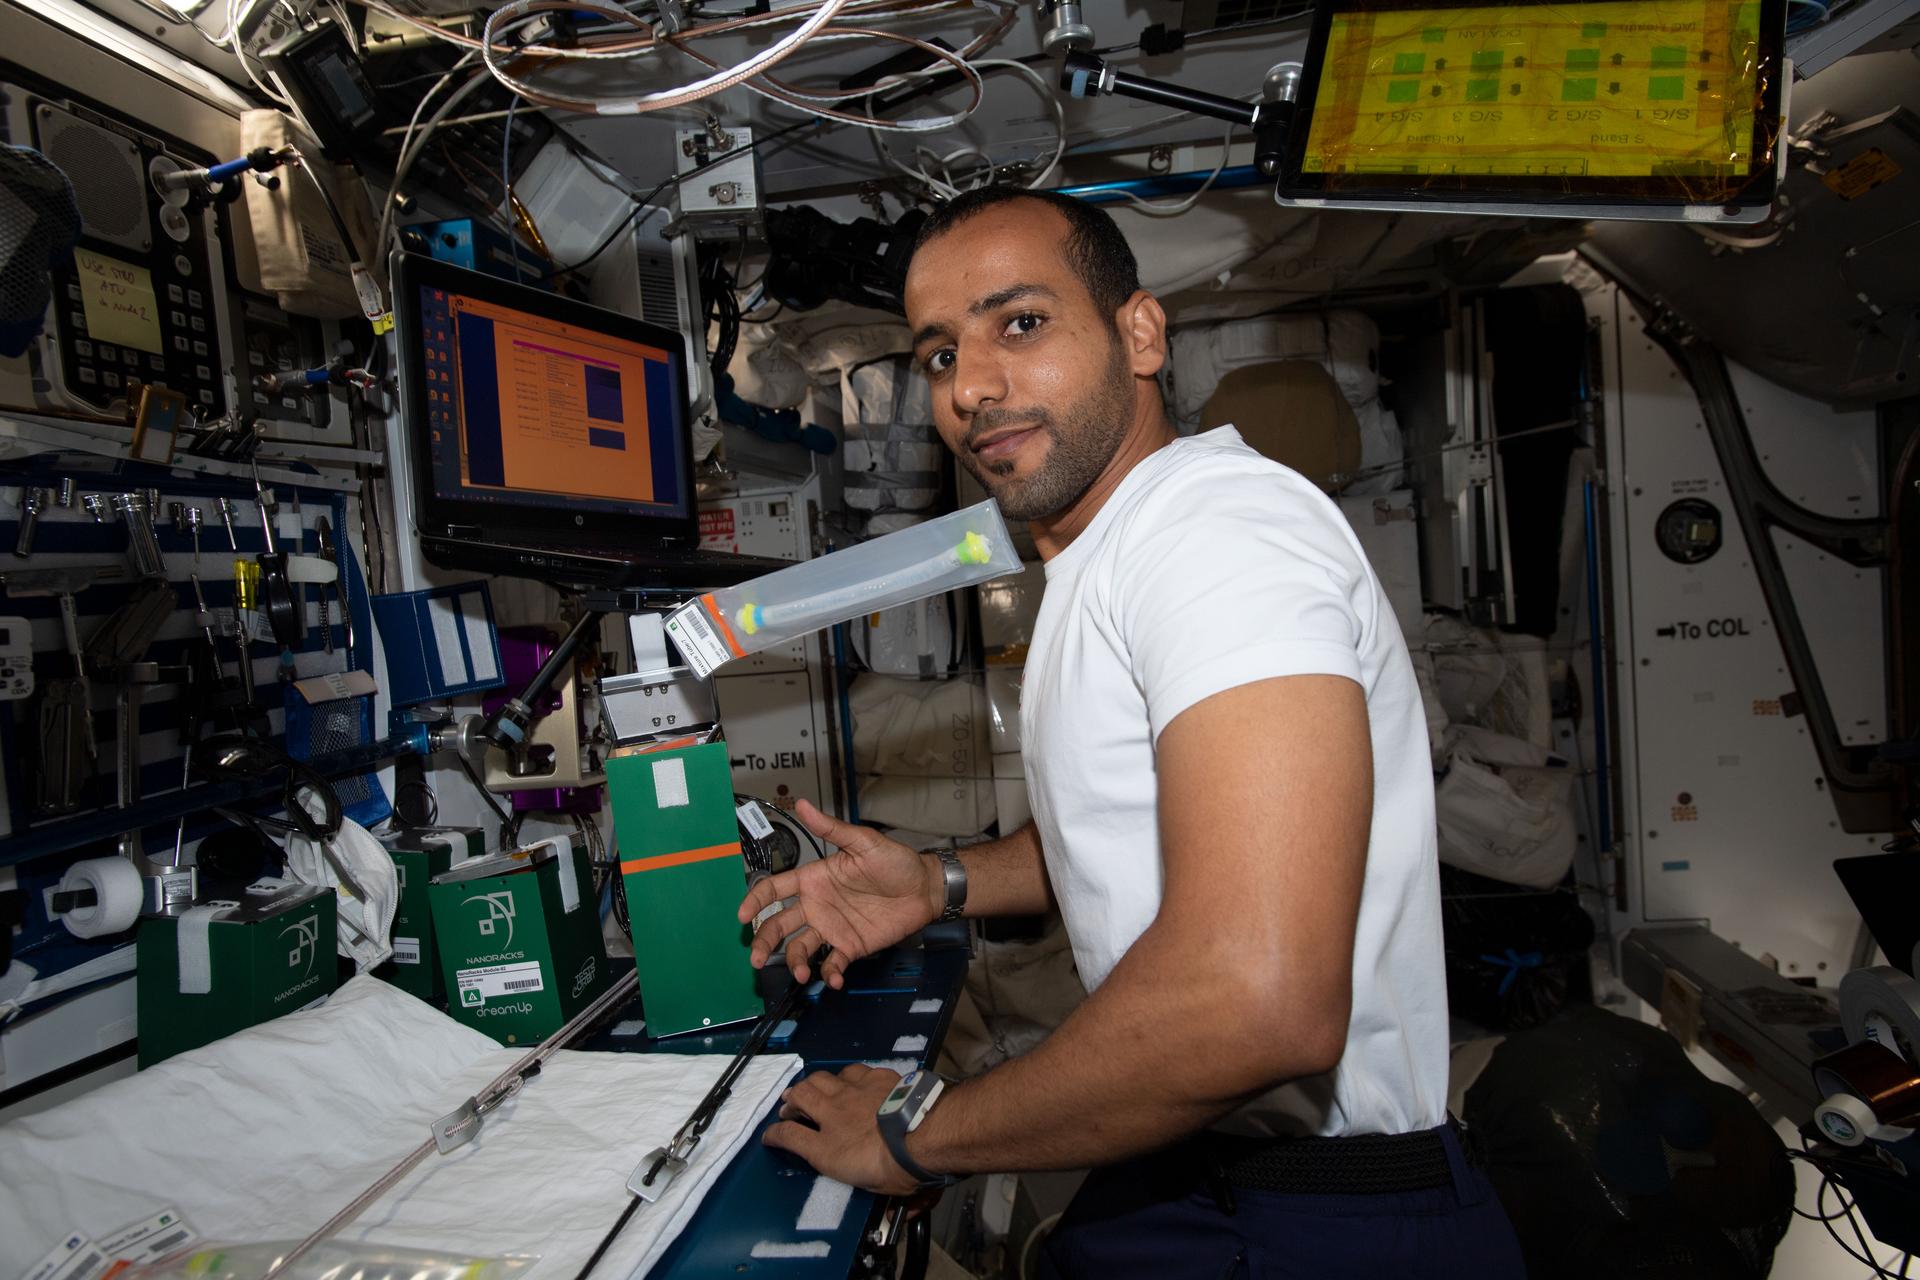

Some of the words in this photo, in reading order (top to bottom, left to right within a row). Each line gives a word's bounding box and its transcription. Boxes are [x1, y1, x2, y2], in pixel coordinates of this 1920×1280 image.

[1375, 112, 1384, 122] 4
[1391, 112, 1423, 122] S/G
[1452, 111, 1462, 122] 3
[1470, 111, 1503, 122] S/G
[1547, 110, 1559, 121] 2
[1566, 110, 1602, 121] S/G
[1653, 108, 1690, 120] S/G
[1407, 135, 1465, 144] Ku-Band
[699, 512, 729, 521] WATER
[1677, 621, 1702, 640] To
[1706, 617, 1750, 638] COL
[745, 754, 766, 770] To
[771, 751, 806, 769] JEM
[465, 950, 525, 965] NANORACKS
[273, 974, 321, 1004] NANORACKS
[476, 1002, 533, 1017] dreamUp
